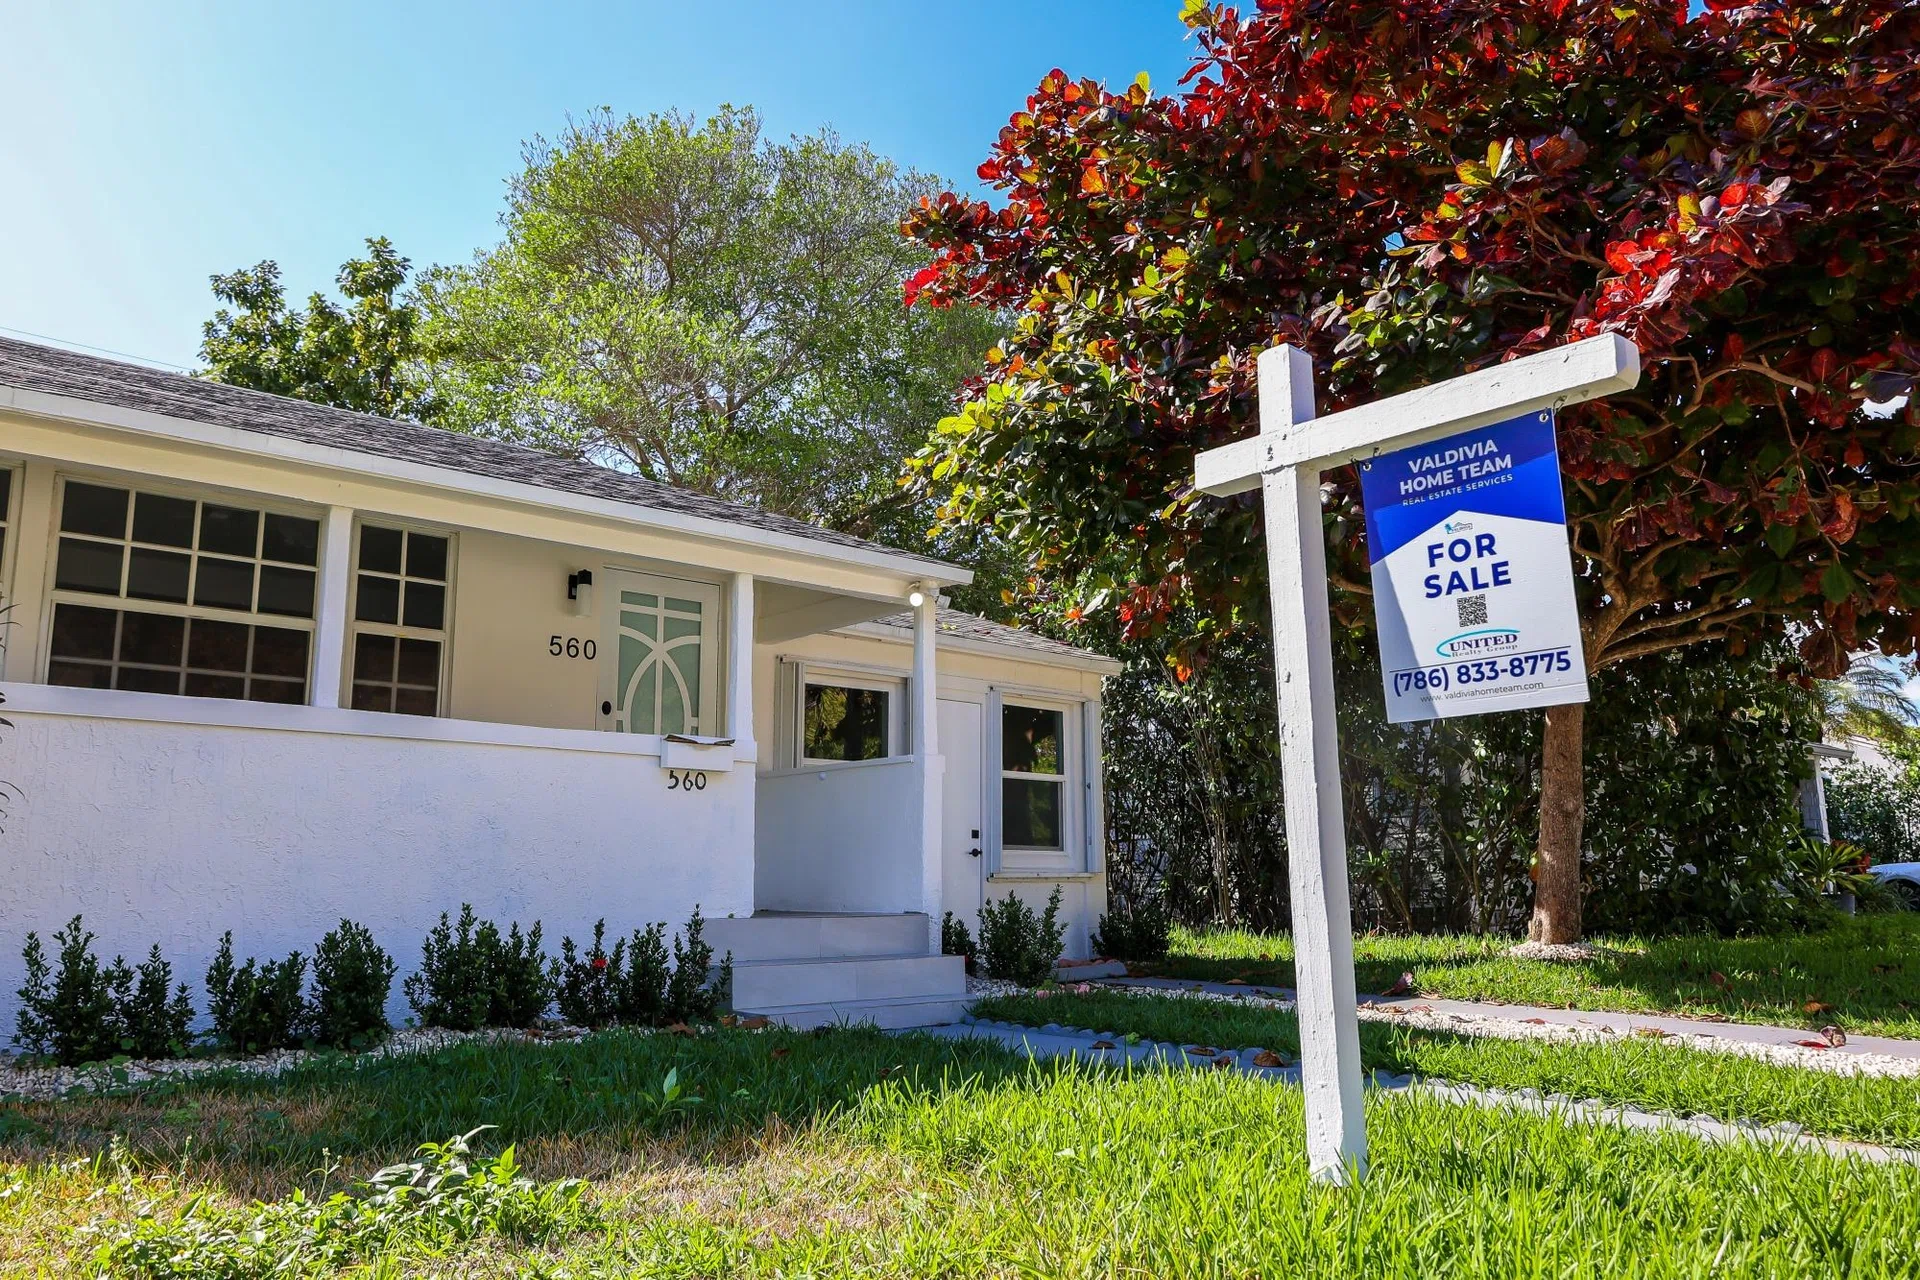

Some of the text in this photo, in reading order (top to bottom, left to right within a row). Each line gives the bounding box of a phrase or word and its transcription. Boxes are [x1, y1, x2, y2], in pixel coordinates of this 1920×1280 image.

[1408, 439, 1498, 474] VALDIVIA
[1400, 454, 1512, 495] HOME TEAM
[1402, 473, 1513, 506] REAL ESTATE SERVICES
[1427, 533, 1497, 568] FOR
[1424, 561, 1512, 599] SALE
[549, 635, 597, 660] 560
[1449, 633, 1518, 652] UNITED
[1451, 644, 1518, 658] Realty Group
[1394, 651, 1571, 697] (786) 833-8775
[667, 770, 707, 791] 560
